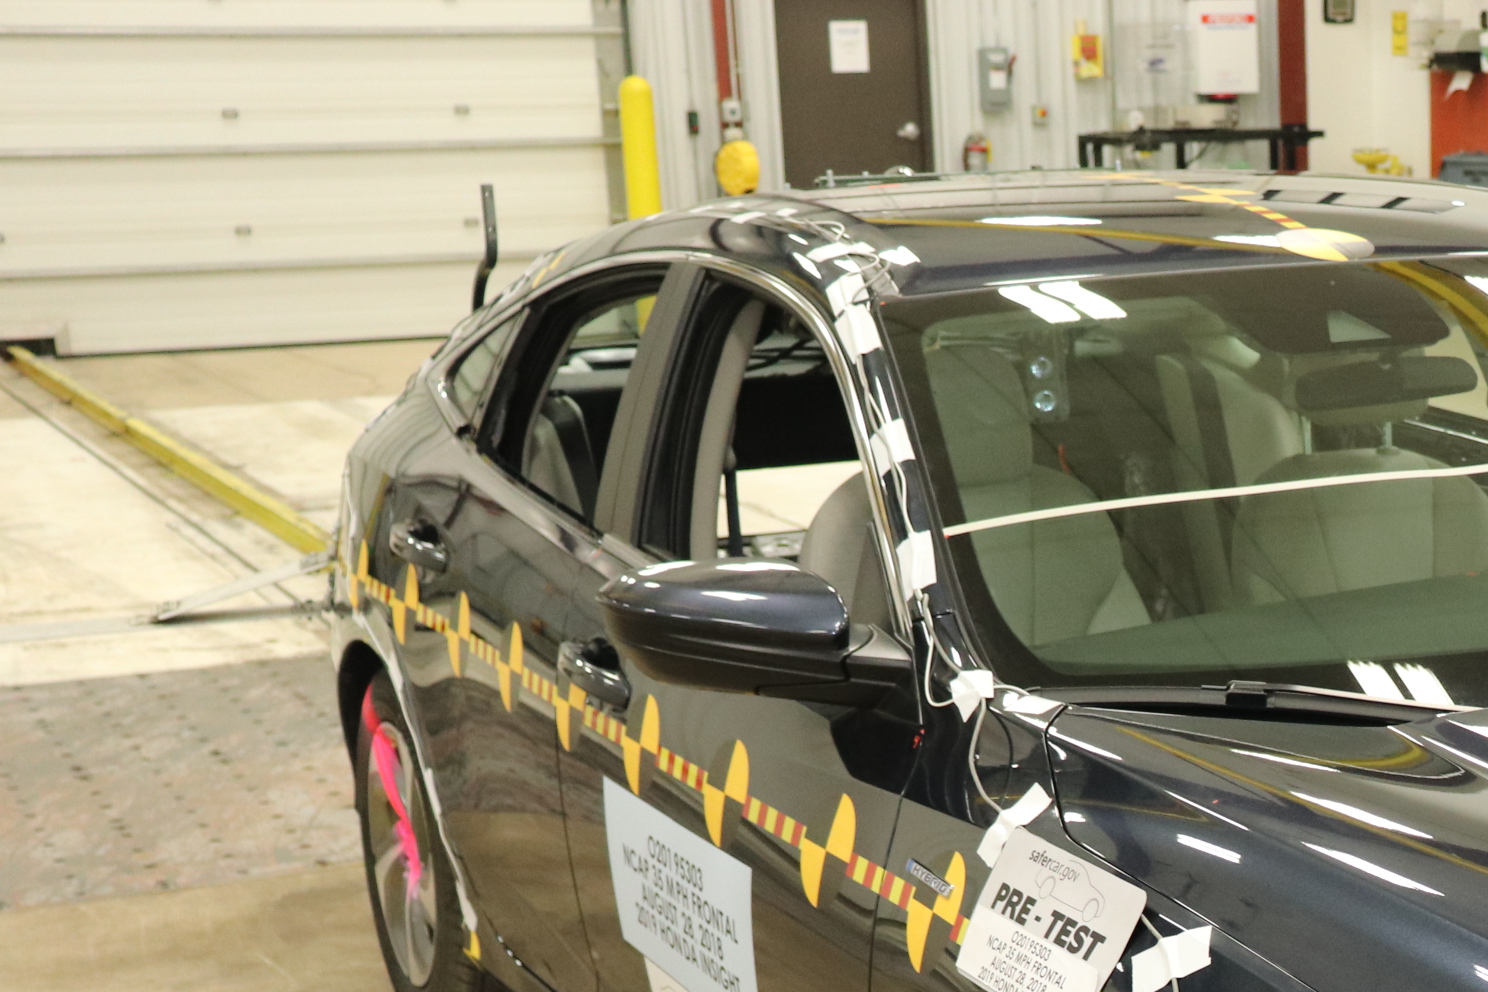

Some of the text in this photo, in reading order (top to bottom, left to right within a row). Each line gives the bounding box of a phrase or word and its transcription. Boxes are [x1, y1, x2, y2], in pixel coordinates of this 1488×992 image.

[1028, 849, 1081, 882] safercar.gov
[622, 843, 739, 944] NCAP 35 MPH FRONTAL
[635, 902, 658, 935] 2019
[642, 882, 679, 929] AUGUST
[699, 923, 724, 961] 2018
[1043, 909, 1107, 962] TEST
[978, 965, 994, 983] 2019
[986, 934, 1067, 990] NCAP 35 MPH FRONTAL
[990, 955, 1018, 981] AUGUST
